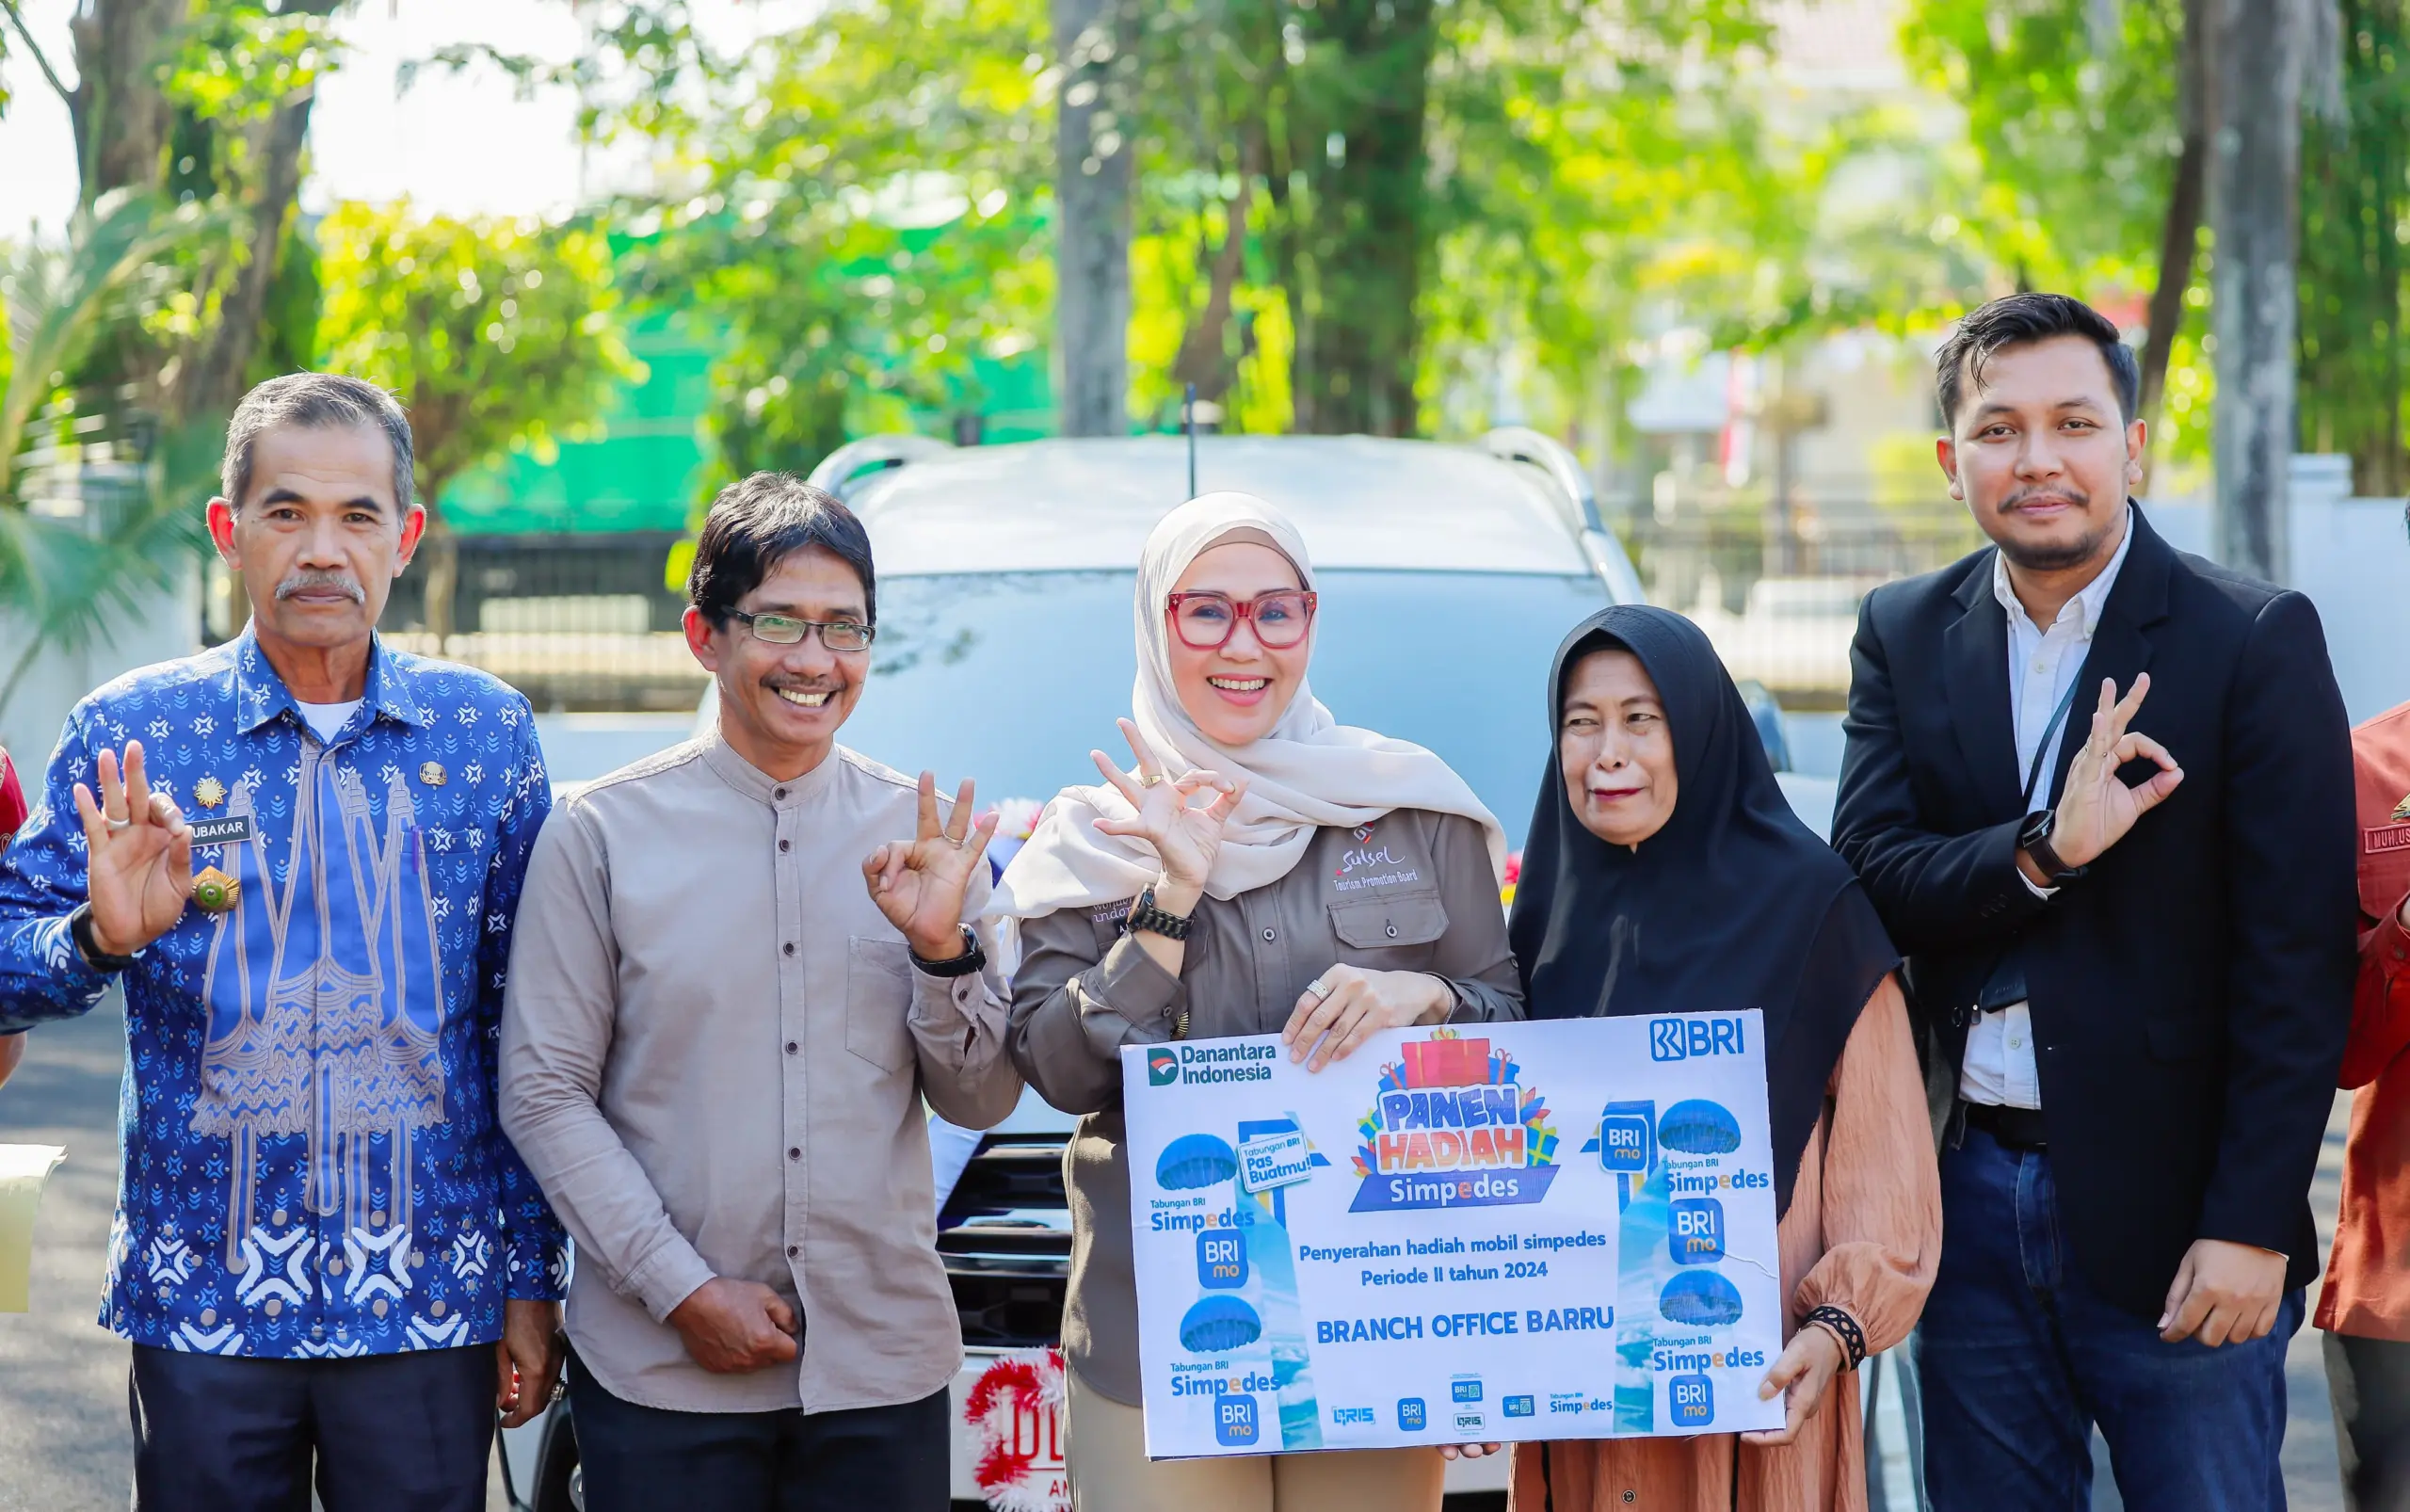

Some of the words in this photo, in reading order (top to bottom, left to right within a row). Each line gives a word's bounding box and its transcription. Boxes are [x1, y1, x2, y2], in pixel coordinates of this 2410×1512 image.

[192, 821, 244, 838] UBAKAR
[1333, 878, 1361, 892] Tourism
[1362, 873, 1397, 888] Promotion
[1397, 869, 1418, 882] Board
[1688, 1018, 1744, 1056] BRI
[1181, 1043, 1277, 1065] Danantara
[1182, 1064, 1272, 1085] Indonesia
[1382, 1088, 1518, 1131] PANEN
[1244, 1141, 1286, 1157] Tabungan
[1286, 1137, 1300, 1148] BRI
[1608, 1128, 1640, 1147] BRI
[1378, 1128, 1524, 1170] HADIAH
[1615, 1149, 1641, 1160] mo
[1246, 1155, 1274, 1170] Pas
[1248, 1157, 1312, 1184] Buatmu!
[1663, 1159, 1703, 1170] Tabungan
[1705, 1158, 1719, 1167] BRI
[1390, 1174, 1519, 1206] Simpedes
[1663, 1168, 1769, 1196] Simpedes
[1150, 1198, 1191, 1210] Tabungan
[1193, 1198, 1206, 1206] BRI
[1150, 1207, 1255, 1233] Simpedes
[1677, 1210, 1715, 1235] BRI
[1205, 1240, 1239, 1263] BRI
[1300, 1239, 1401, 1262] Penyerahan
[1406, 1237, 1466, 1256] hadiah
[1470, 1234, 1518, 1252] mobil
[1523, 1231, 1606, 1252] simpedes
[1686, 1237, 1717, 1252] mo
[1213, 1264, 1240, 1278] mo
[1361, 1267, 1428, 1286] Periode
[1450, 1263, 1499, 1281] tahun
[1504, 1261, 1549, 1279] 2024
[1317, 1316, 1423, 1344] BRANCH
[1432, 1311, 1518, 1339] OFFICE
[1526, 1306, 1615, 1333] BARRU
[1653, 1337, 1695, 1348] Tabungan
[1697, 1335, 1712, 1344] BRI
[1170, 1362, 1213, 1374] Tabungan
[1215, 1360, 1229, 1370] BRI
[1653, 1346, 1765, 1375] Simpedes
[1171, 1371, 1281, 1398] Simpedes
[1677, 1384, 1706, 1404] BRI
[1221, 1404, 1251, 1424] BRI
[1402, 1404, 1422, 1417] BRI
[1550, 1398, 1613, 1414] Simpedes
[1683, 1406, 1708, 1417] mo
[1333, 1407, 1374, 1426] QRIS
[1456, 1416, 1482, 1428] QRIS
[1229, 1425, 1253, 1437] mo
